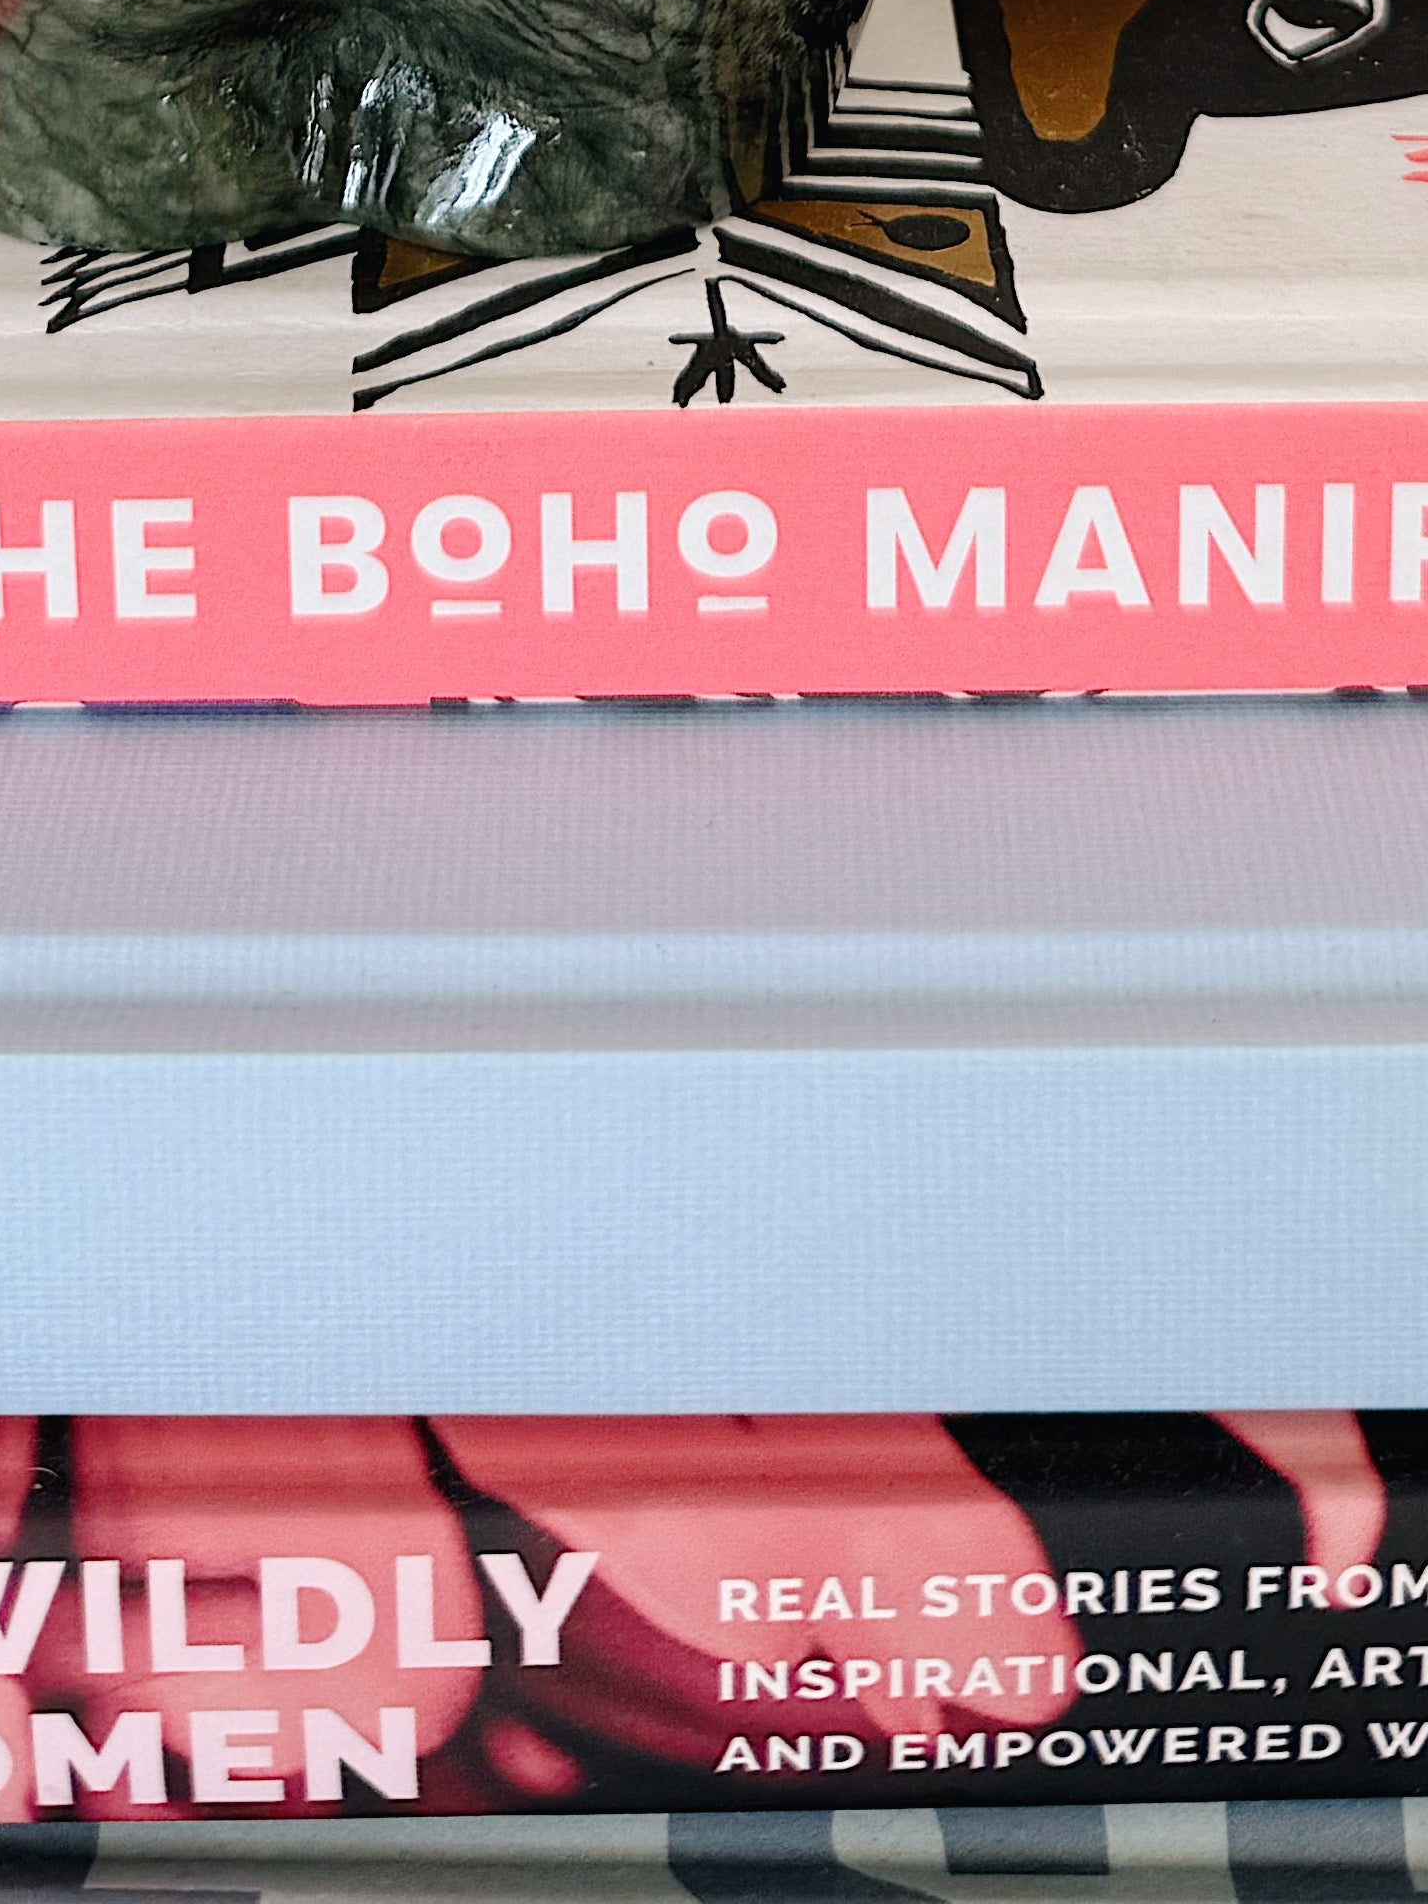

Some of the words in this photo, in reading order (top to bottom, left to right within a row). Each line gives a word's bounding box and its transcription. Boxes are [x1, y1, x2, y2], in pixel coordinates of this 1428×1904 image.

[719, 1577, 896, 1623] REAL
[920, 1567, 1221, 1620] STORIES
[718, 1649, 1288, 1702] INSPIRATIONAL,
[714, 1734, 865, 1773] AND
[888, 1724, 1344, 1771] EMPOWERED
